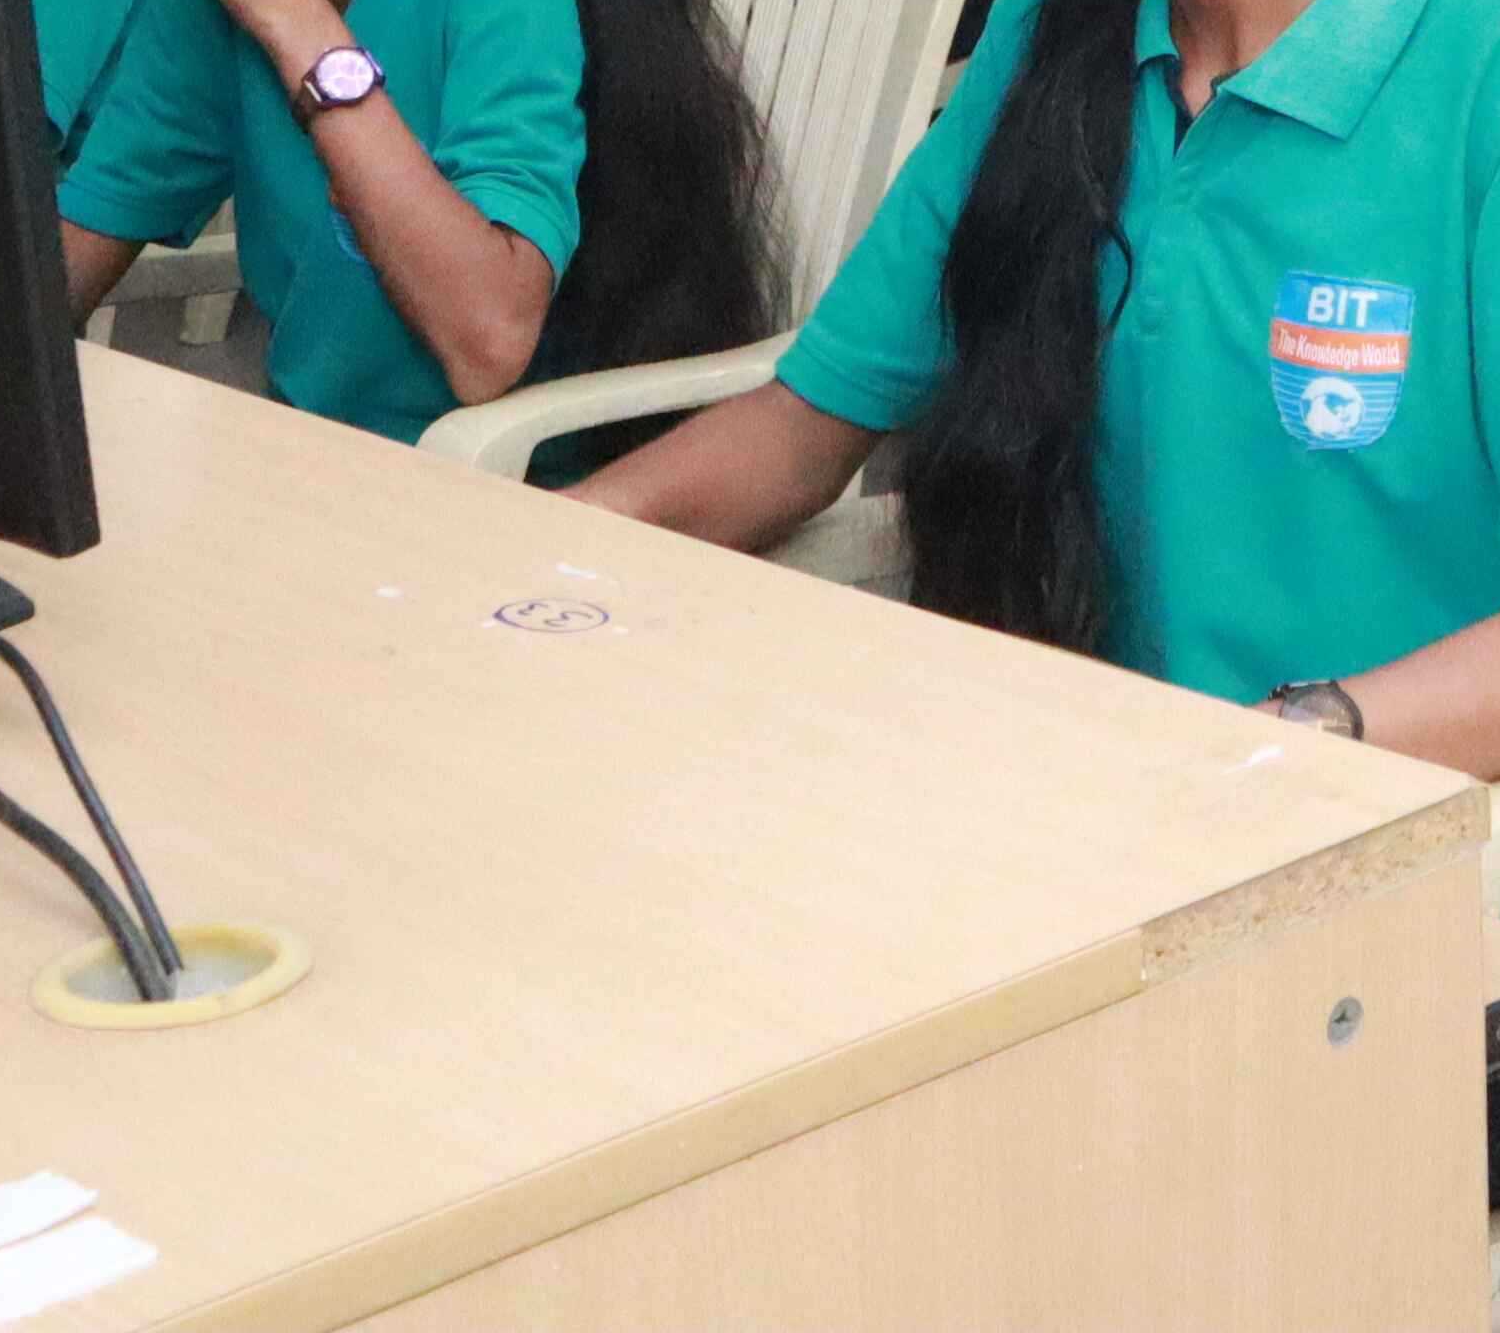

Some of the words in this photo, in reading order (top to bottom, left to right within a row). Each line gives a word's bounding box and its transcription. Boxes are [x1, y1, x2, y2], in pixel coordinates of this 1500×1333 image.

[1307, 286, 1380, 328] BIT
[1276, 327, 1297, 359] The
[1296, 334, 1360, 370] Knowledge
